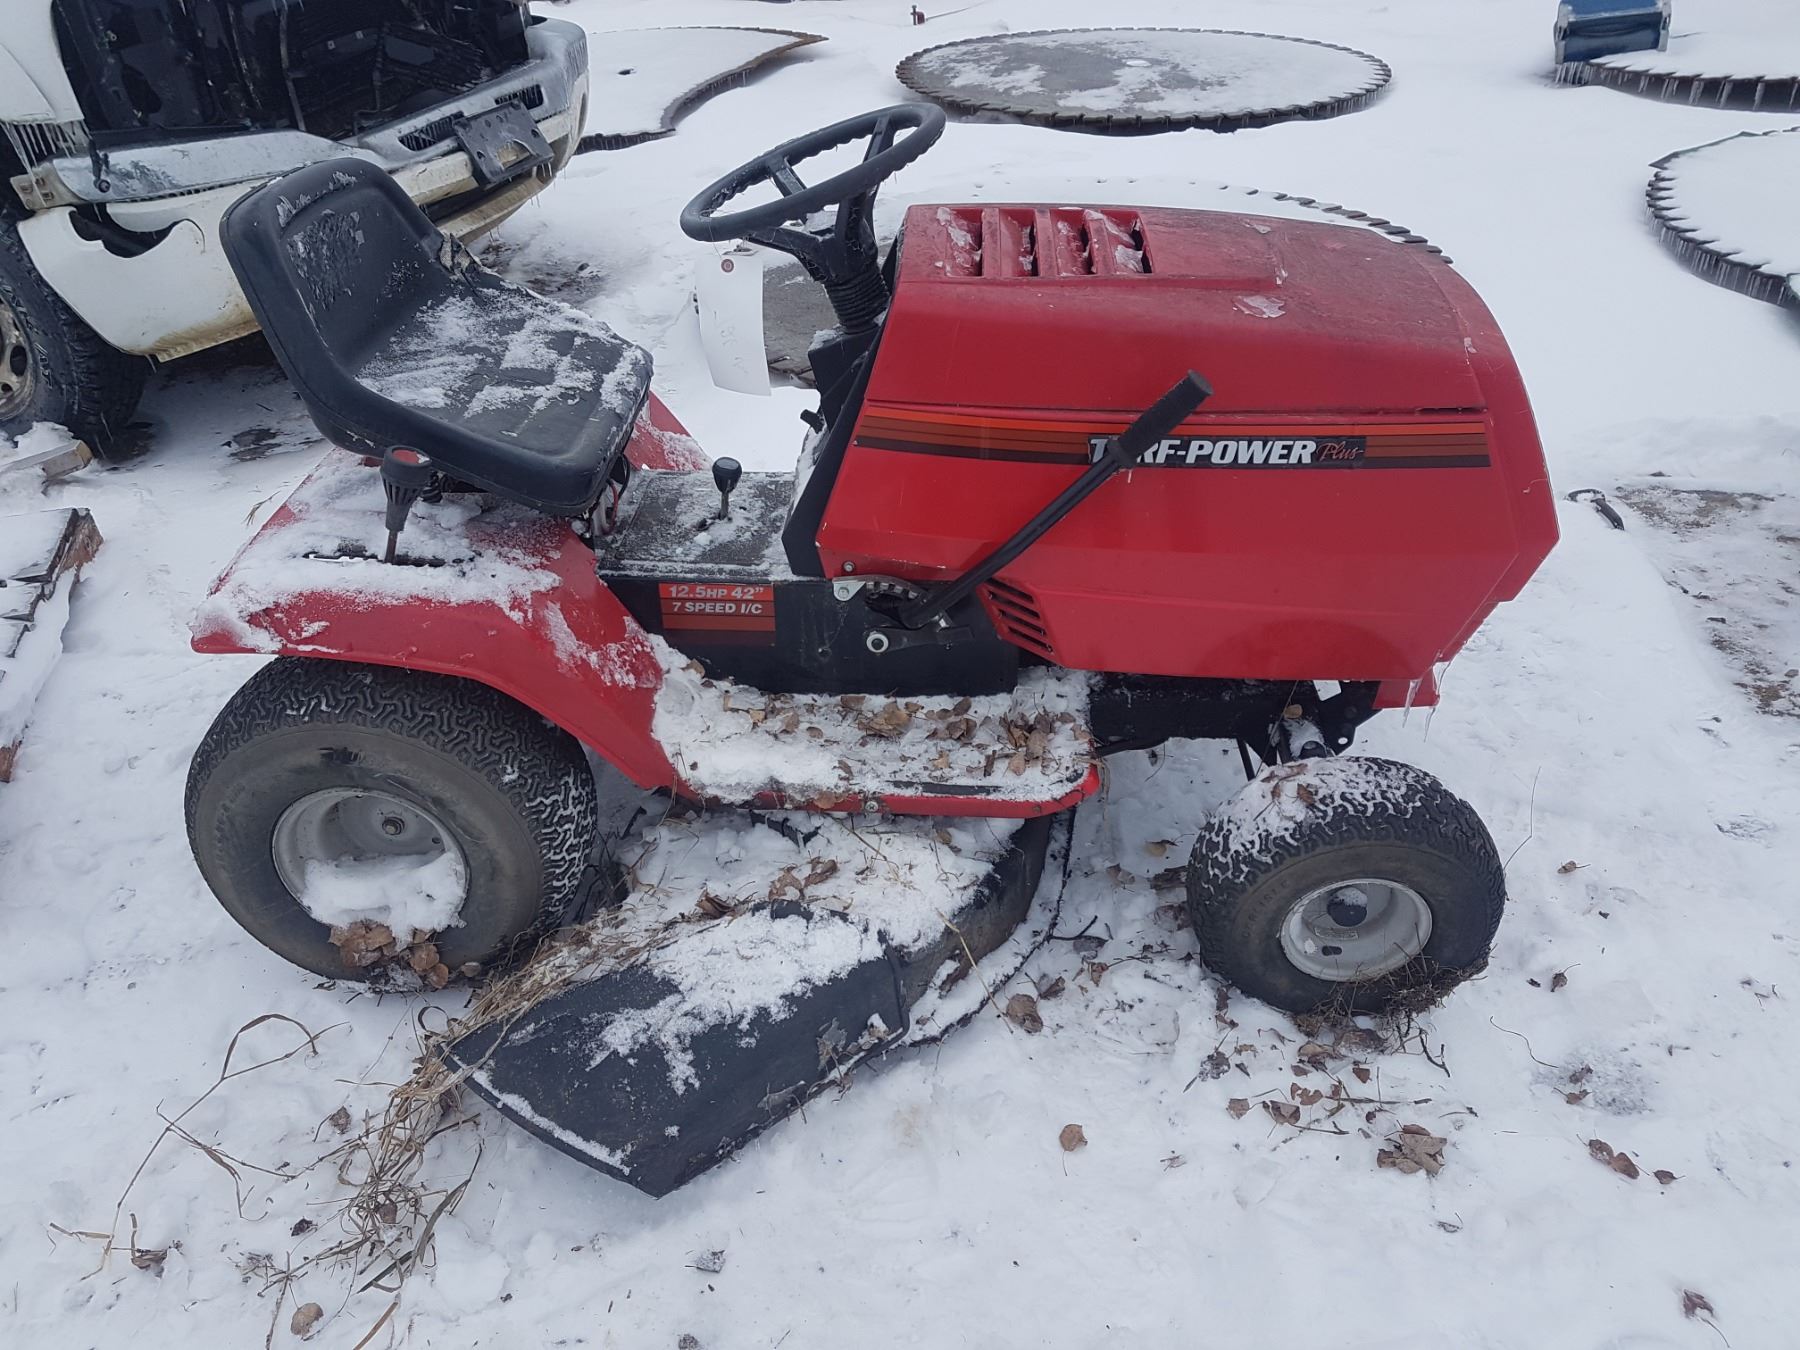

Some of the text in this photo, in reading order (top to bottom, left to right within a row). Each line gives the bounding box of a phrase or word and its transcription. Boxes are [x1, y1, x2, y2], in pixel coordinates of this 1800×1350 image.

[1090, 439, 1364, 464] TF-POWER Plus
[669, 586, 728, 598] 12.5HP
[673, 602, 763, 614] 7 SPEED I/C
